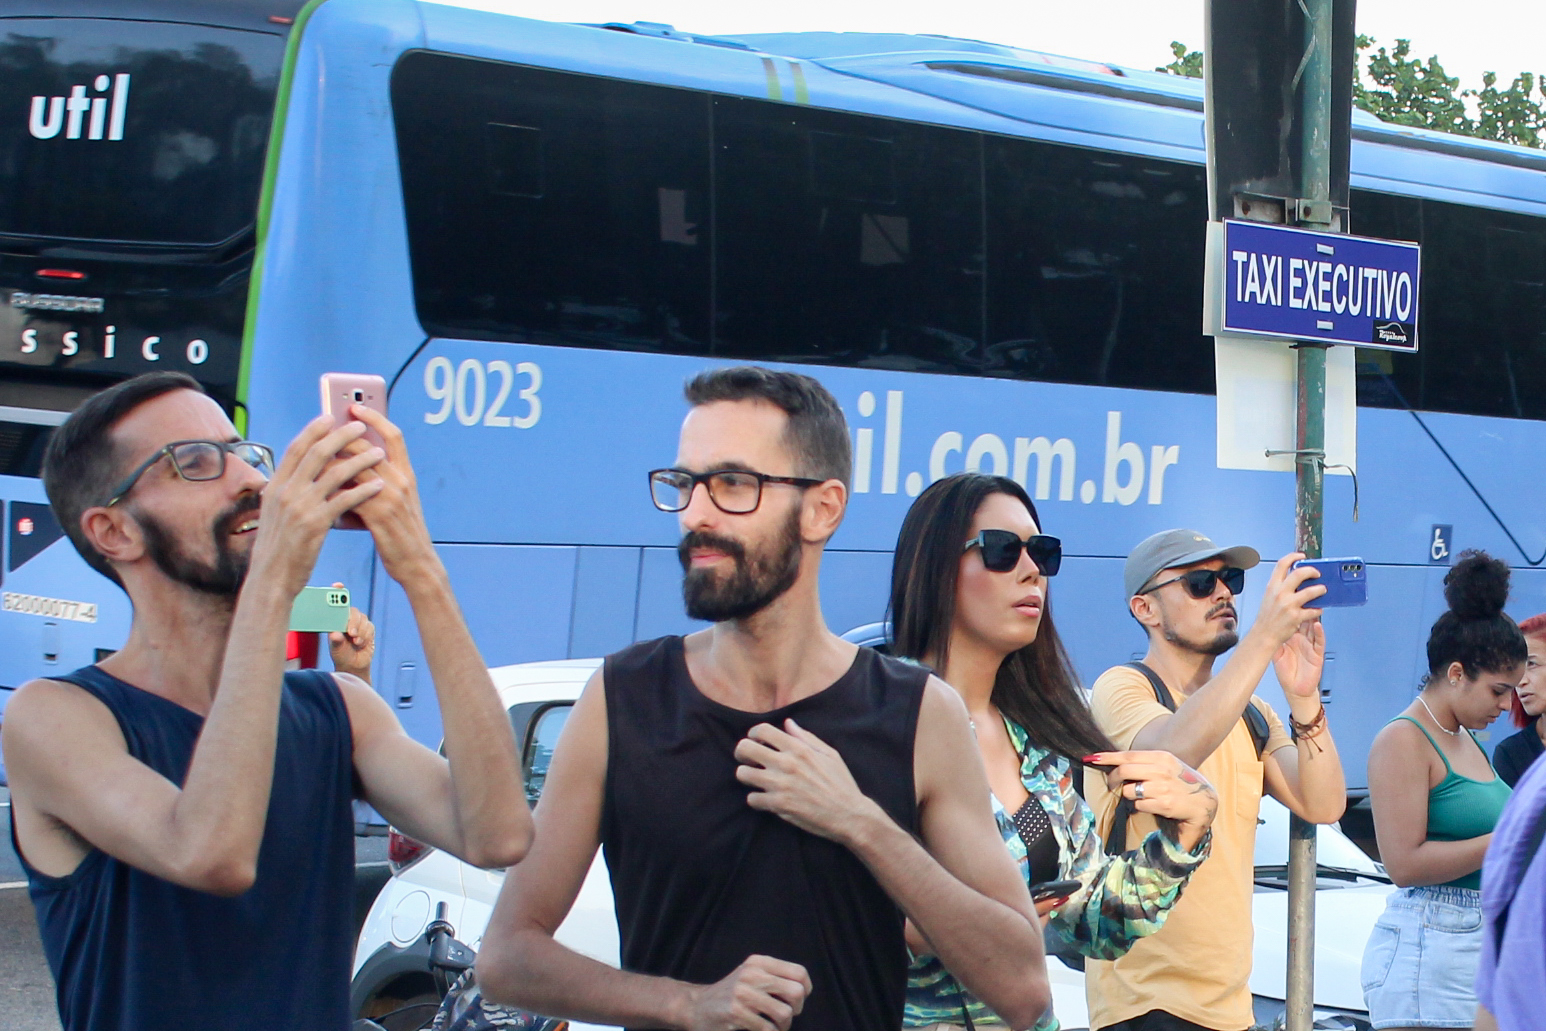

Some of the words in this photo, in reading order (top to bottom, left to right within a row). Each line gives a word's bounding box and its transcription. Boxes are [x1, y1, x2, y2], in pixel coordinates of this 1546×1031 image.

[29, 73, 131, 141] util
[1232, 250, 1283, 306] TAXI
[1289, 258, 1412, 321] EXECUTIVO
[423, 356, 543, 429] 9023
[841, 390, 1180, 506] il.com.br
